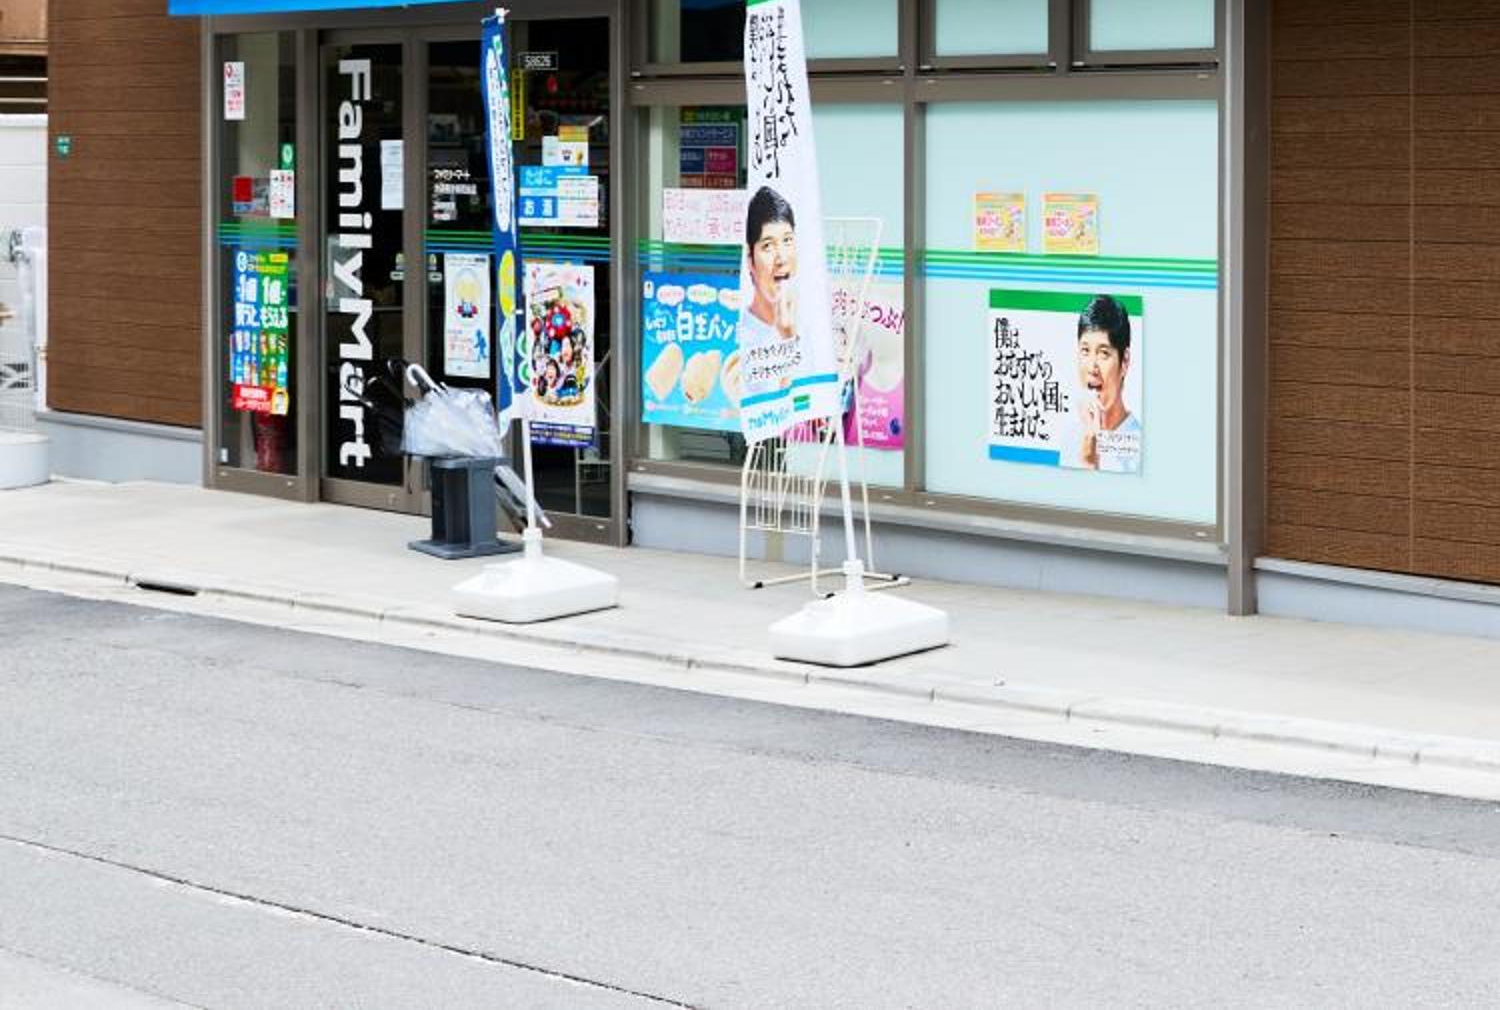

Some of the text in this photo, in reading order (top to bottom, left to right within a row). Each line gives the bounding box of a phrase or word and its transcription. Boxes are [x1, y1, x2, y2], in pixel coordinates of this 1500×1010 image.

[334, 58, 373, 467] FamilyMart
[994, 317, 1020, 349] 僕は
[994, 349, 1053, 380] おむすびの
[994, 379, 1069, 413] おいしい国に
[994, 406, 1050, 441] 生まれた。
